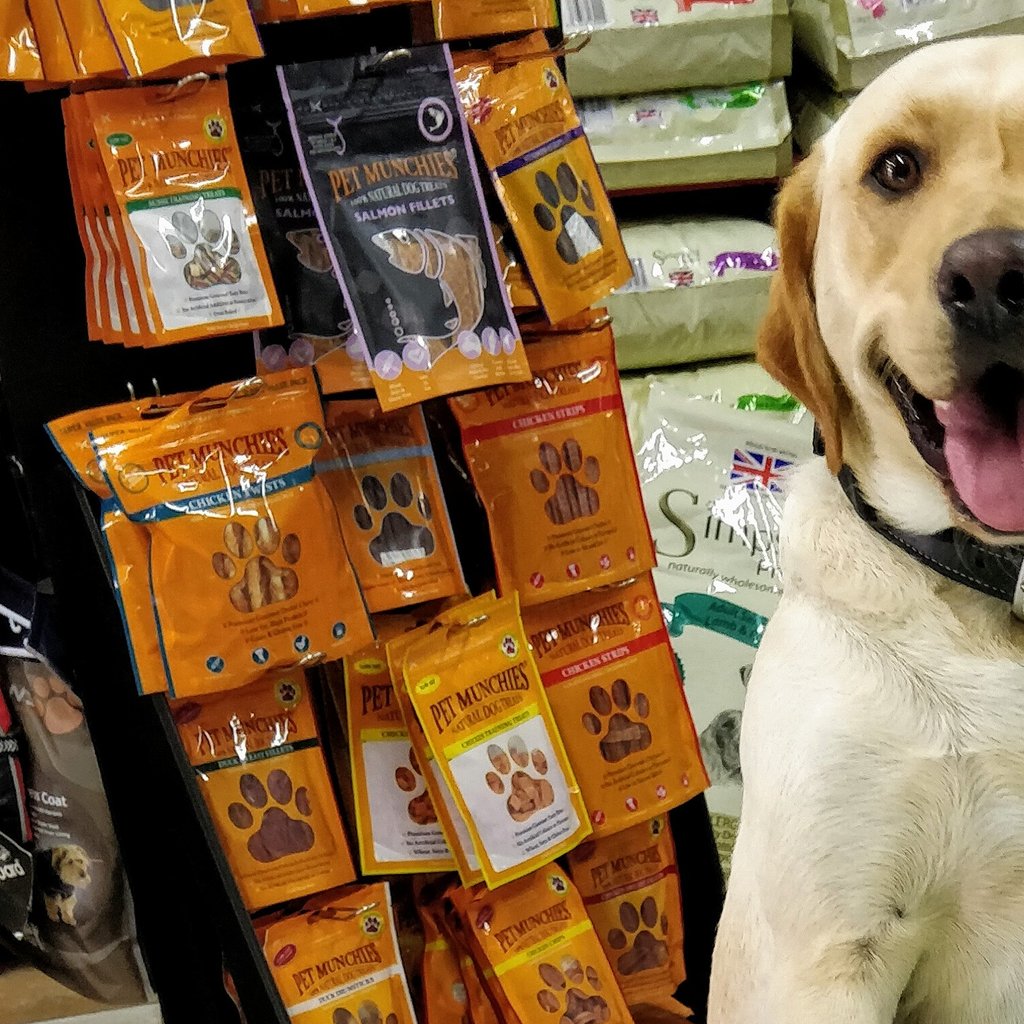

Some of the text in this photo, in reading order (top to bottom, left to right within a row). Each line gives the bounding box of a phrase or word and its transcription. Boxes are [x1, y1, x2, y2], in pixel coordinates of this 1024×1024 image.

[117, 155, 147, 188] PET
[258, 168, 293, 199] PET
[327, 149, 458, 203] PET MUNCHIES
[403, 182, 420, 197] DOG
[353, 194, 455, 223] SALMON FILLETS
[512, 411, 554, 429] CHICKEN
[151, 449, 190, 485] PET
[191, 427, 288, 469] MUNCHIES
[187, 491, 235, 512] CHICKEN
[667, 561, 720, 580] naturally
[530, 603, 630, 659] PET MUNCHIES
[561, 646, 631, 678] CHICKEN STRIPS
[361, 684, 392, 716] PET
[429, 662, 529, 735] PET MUNCHIES
[41, 791, 68, 808] Coat
[494, 899, 573, 954] PET MUNCHIES
[292, 942, 383, 996] PET MUNCHIES
